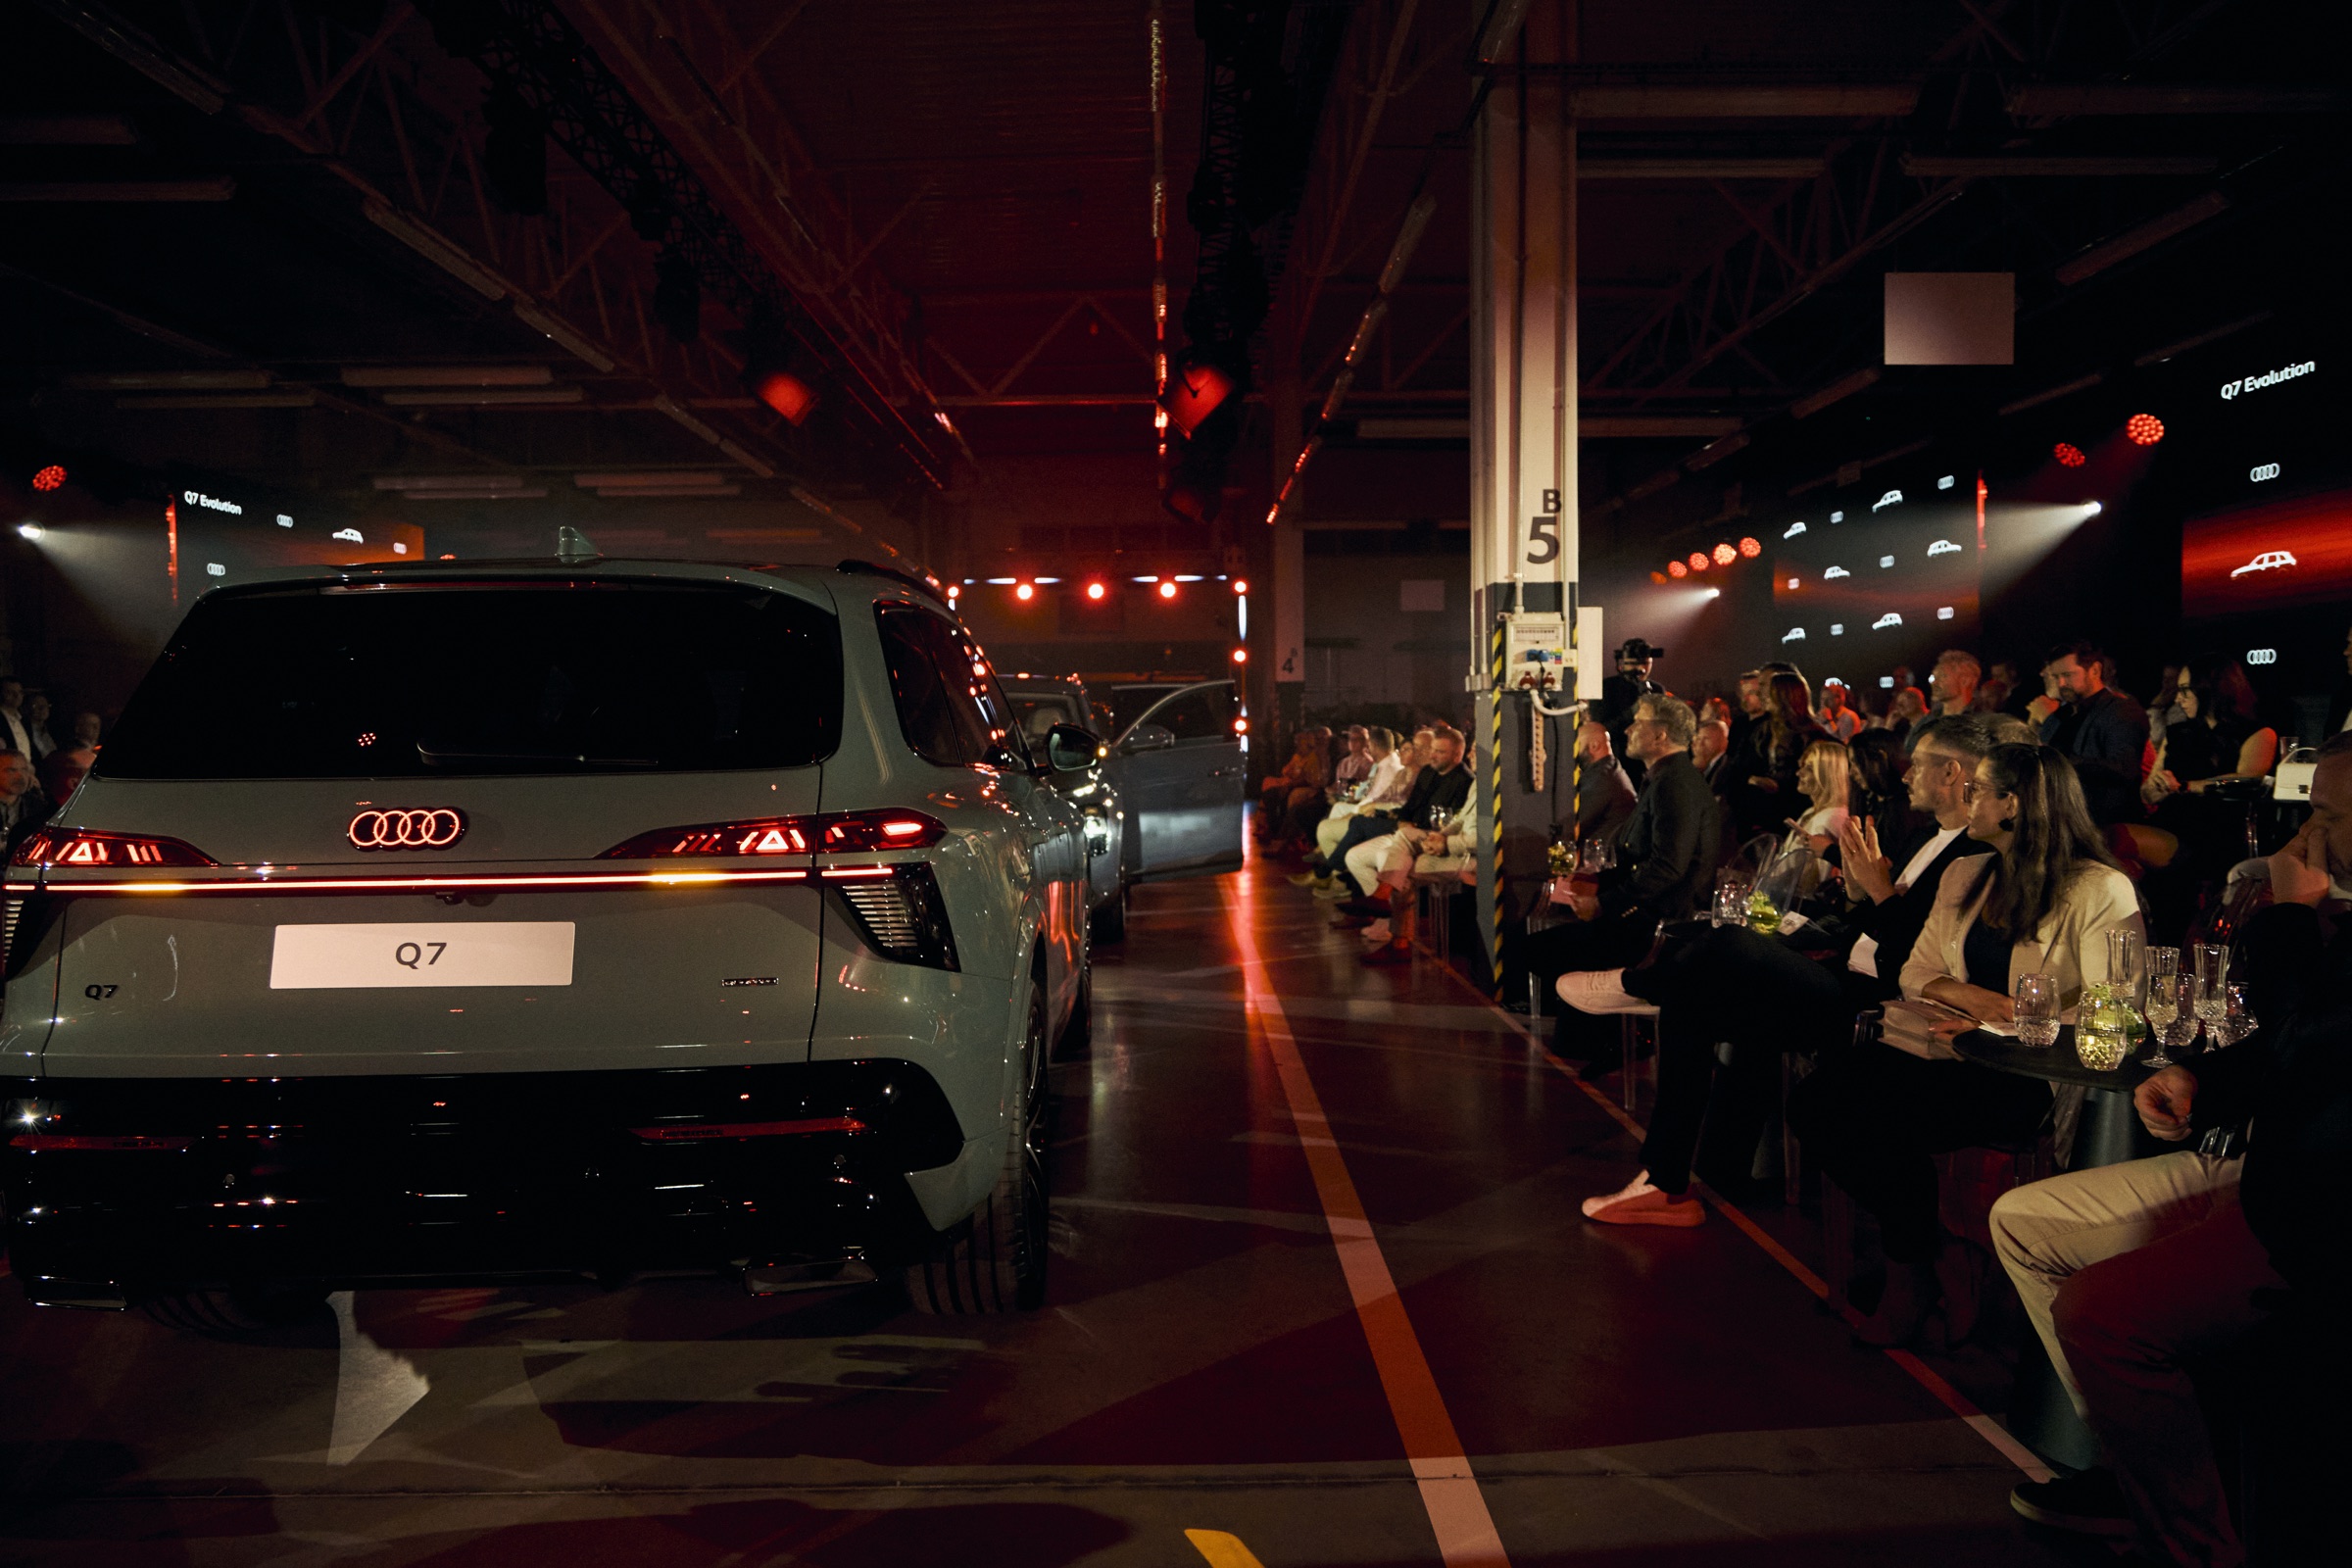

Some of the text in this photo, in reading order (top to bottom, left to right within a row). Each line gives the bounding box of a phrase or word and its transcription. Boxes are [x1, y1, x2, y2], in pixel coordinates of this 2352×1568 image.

[2220, 361, 2315, 400] Q7 Evolution
[184, 491, 242, 515] Q7 Evolution
[1543, 489, 1561, 514] B
[1527, 516, 1560, 564] 5
[395, 942, 447, 970] Q7
[84, 984, 119, 1001] Q7
